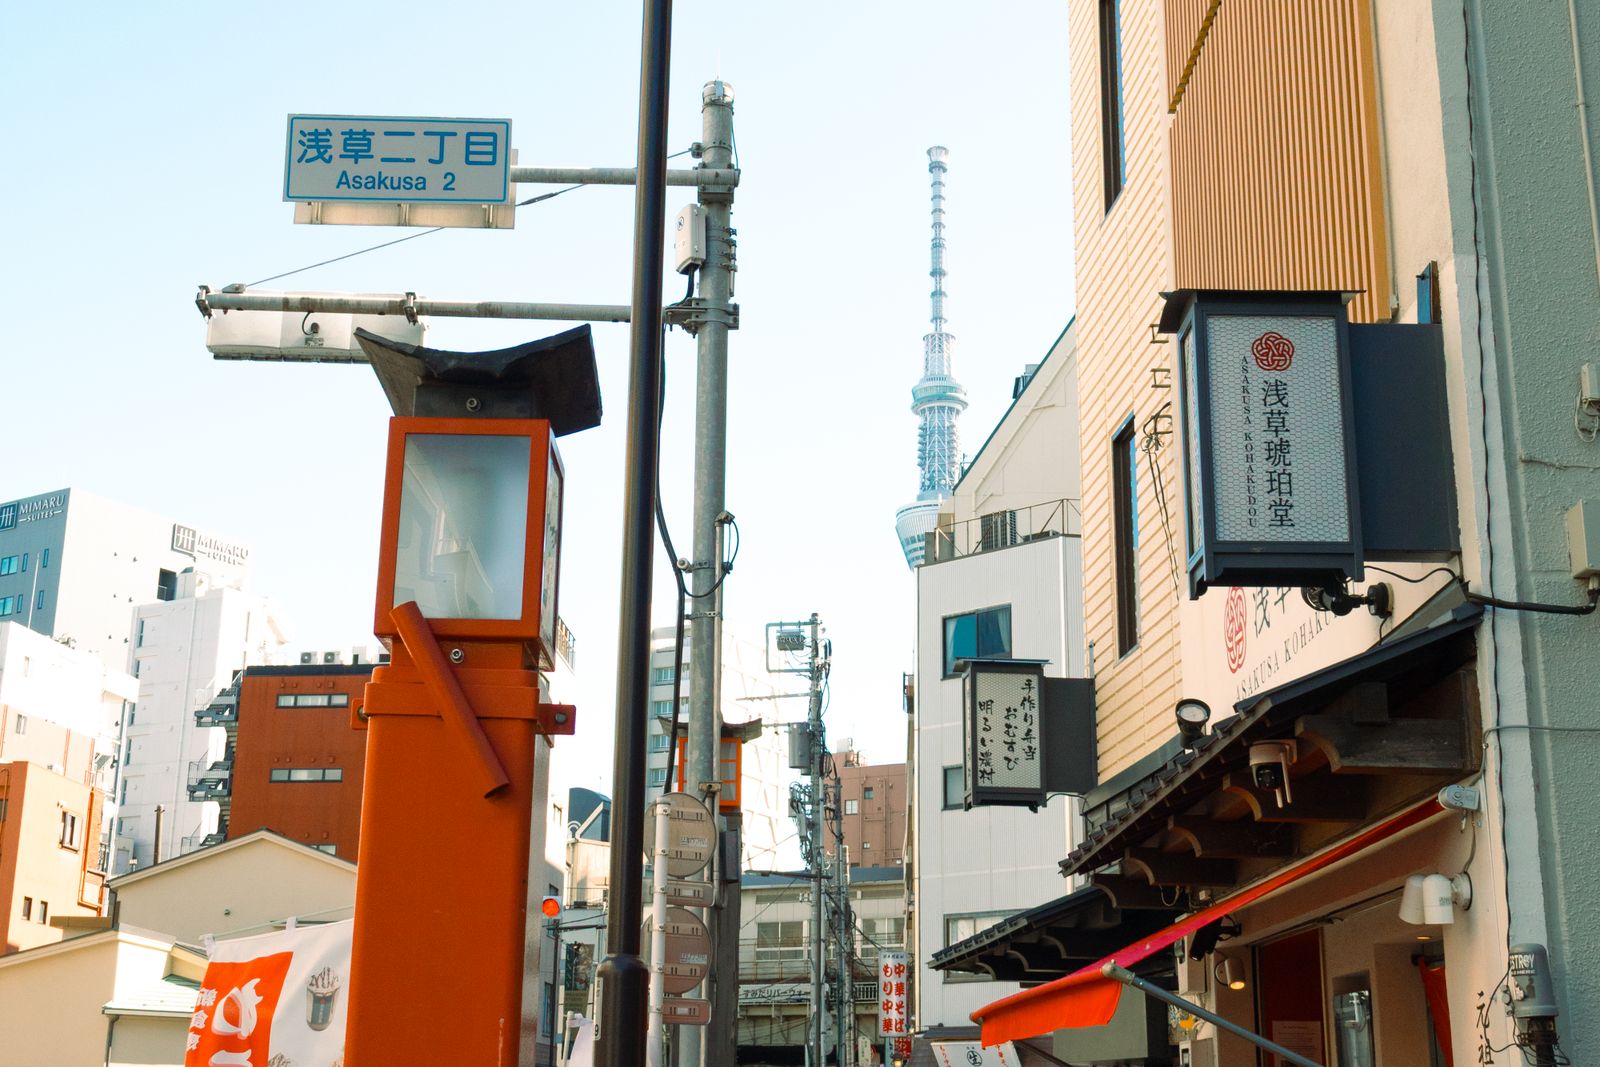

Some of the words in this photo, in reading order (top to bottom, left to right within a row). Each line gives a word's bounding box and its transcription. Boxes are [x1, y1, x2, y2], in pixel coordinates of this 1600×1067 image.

[297, 128, 498, 166] 浅草二丁目
[335, 170, 427, 191] Asakusa
[442, 172, 456, 191] 2
[1241, 356, 1252, 425] ASAKUSA
[1244, 432, 1258, 528] KOHAKUDOU
[1261, 378, 1296, 528] 浅草琥珀堂
[19, 494, 66, 515] MIMARU
[1236, 652, 1280, 703] ASAKUSA
[1284, 611, 1338, 663] KOHAKU
[1003, 706, 1019, 771] おむすび
[1020, 678, 1036, 761] 手作り弁当
[743, 988, 812, 998] すみだリバーウォー
[882, 962, 893, 1033] もり中華
[894, 962, 906, 1033] 中華そば
